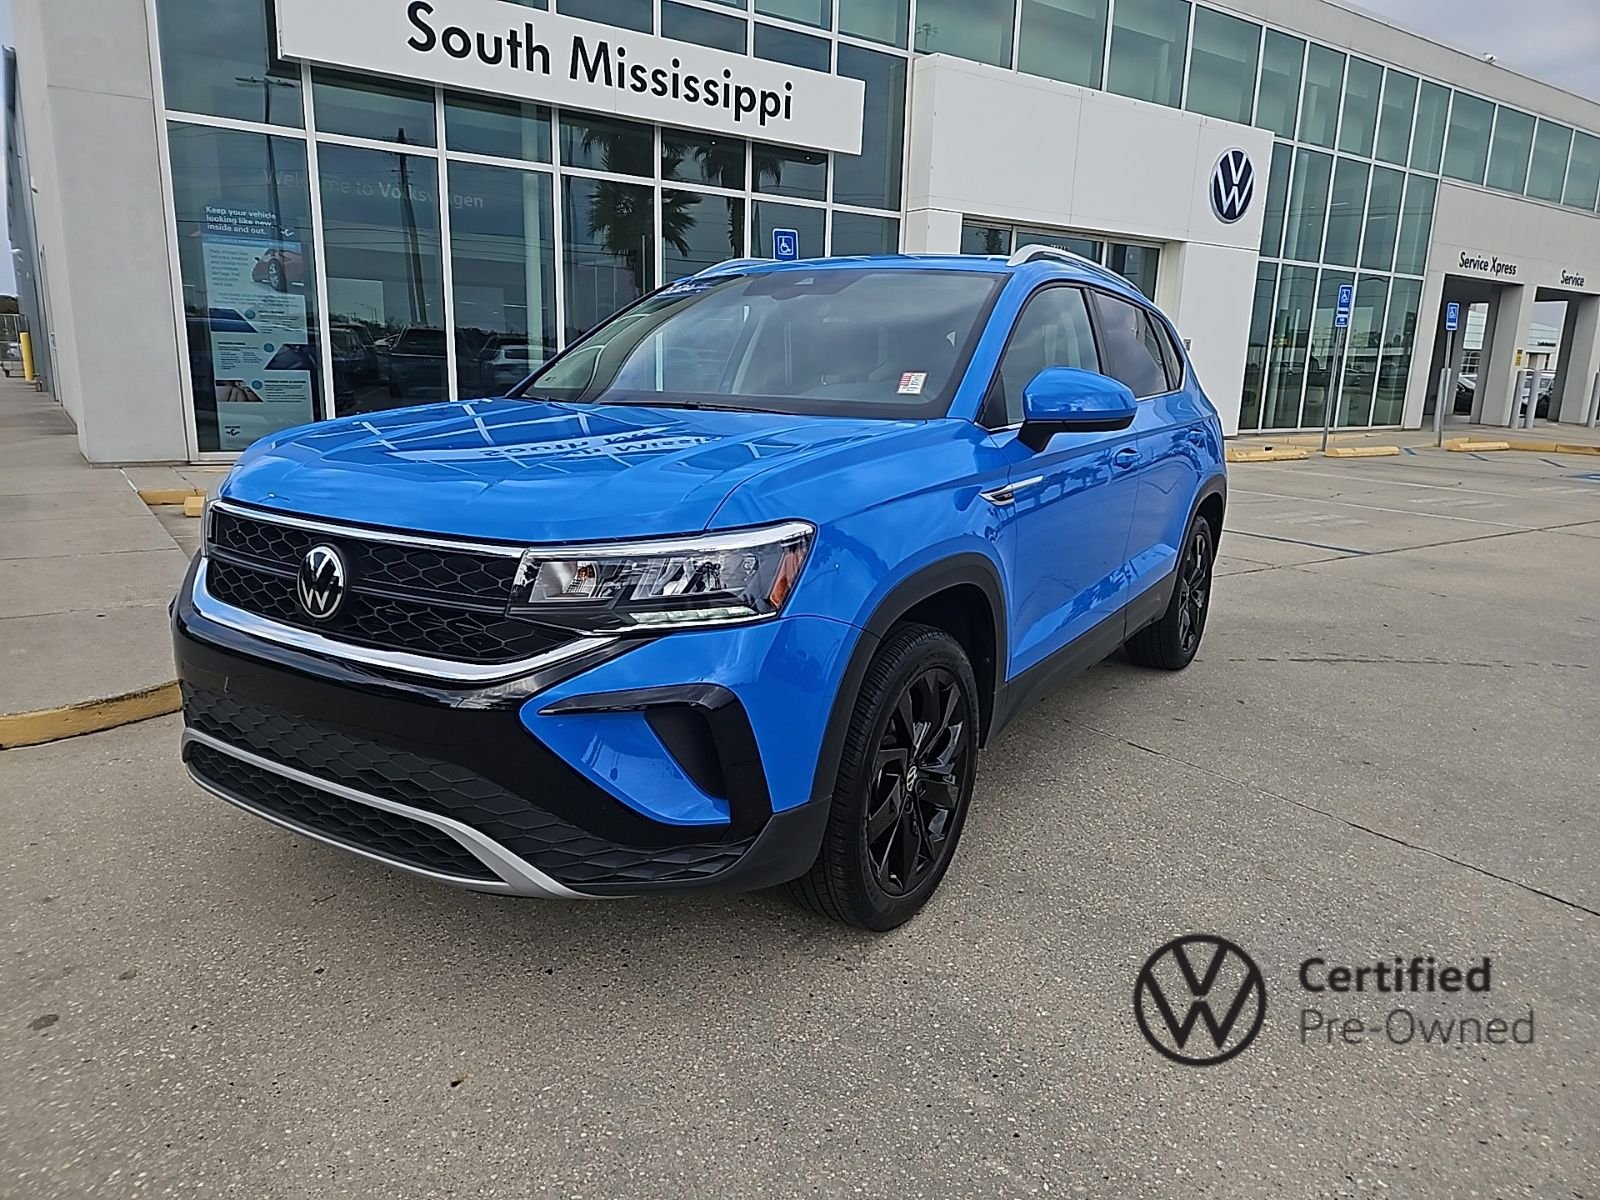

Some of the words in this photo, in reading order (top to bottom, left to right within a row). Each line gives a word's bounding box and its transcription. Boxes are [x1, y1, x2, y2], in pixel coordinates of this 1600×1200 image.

[407, 0, 551, 75] South
[569, 35, 793, 127] Mississippi
[262, 168, 350, 194] Welme
[356, 180, 373, 196] to
[378, 181, 485, 209] Voksgen
[205, 206, 227, 215] Keep
[248, 211, 276, 220] vehicle
[206, 214, 237, 225] looking
[207, 223, 232, 232] inside
[1458, 251, 1489, 272] Service
[1490, 256, 1517, 277] Xpress
[1560, 269, 1585, 287] Service
